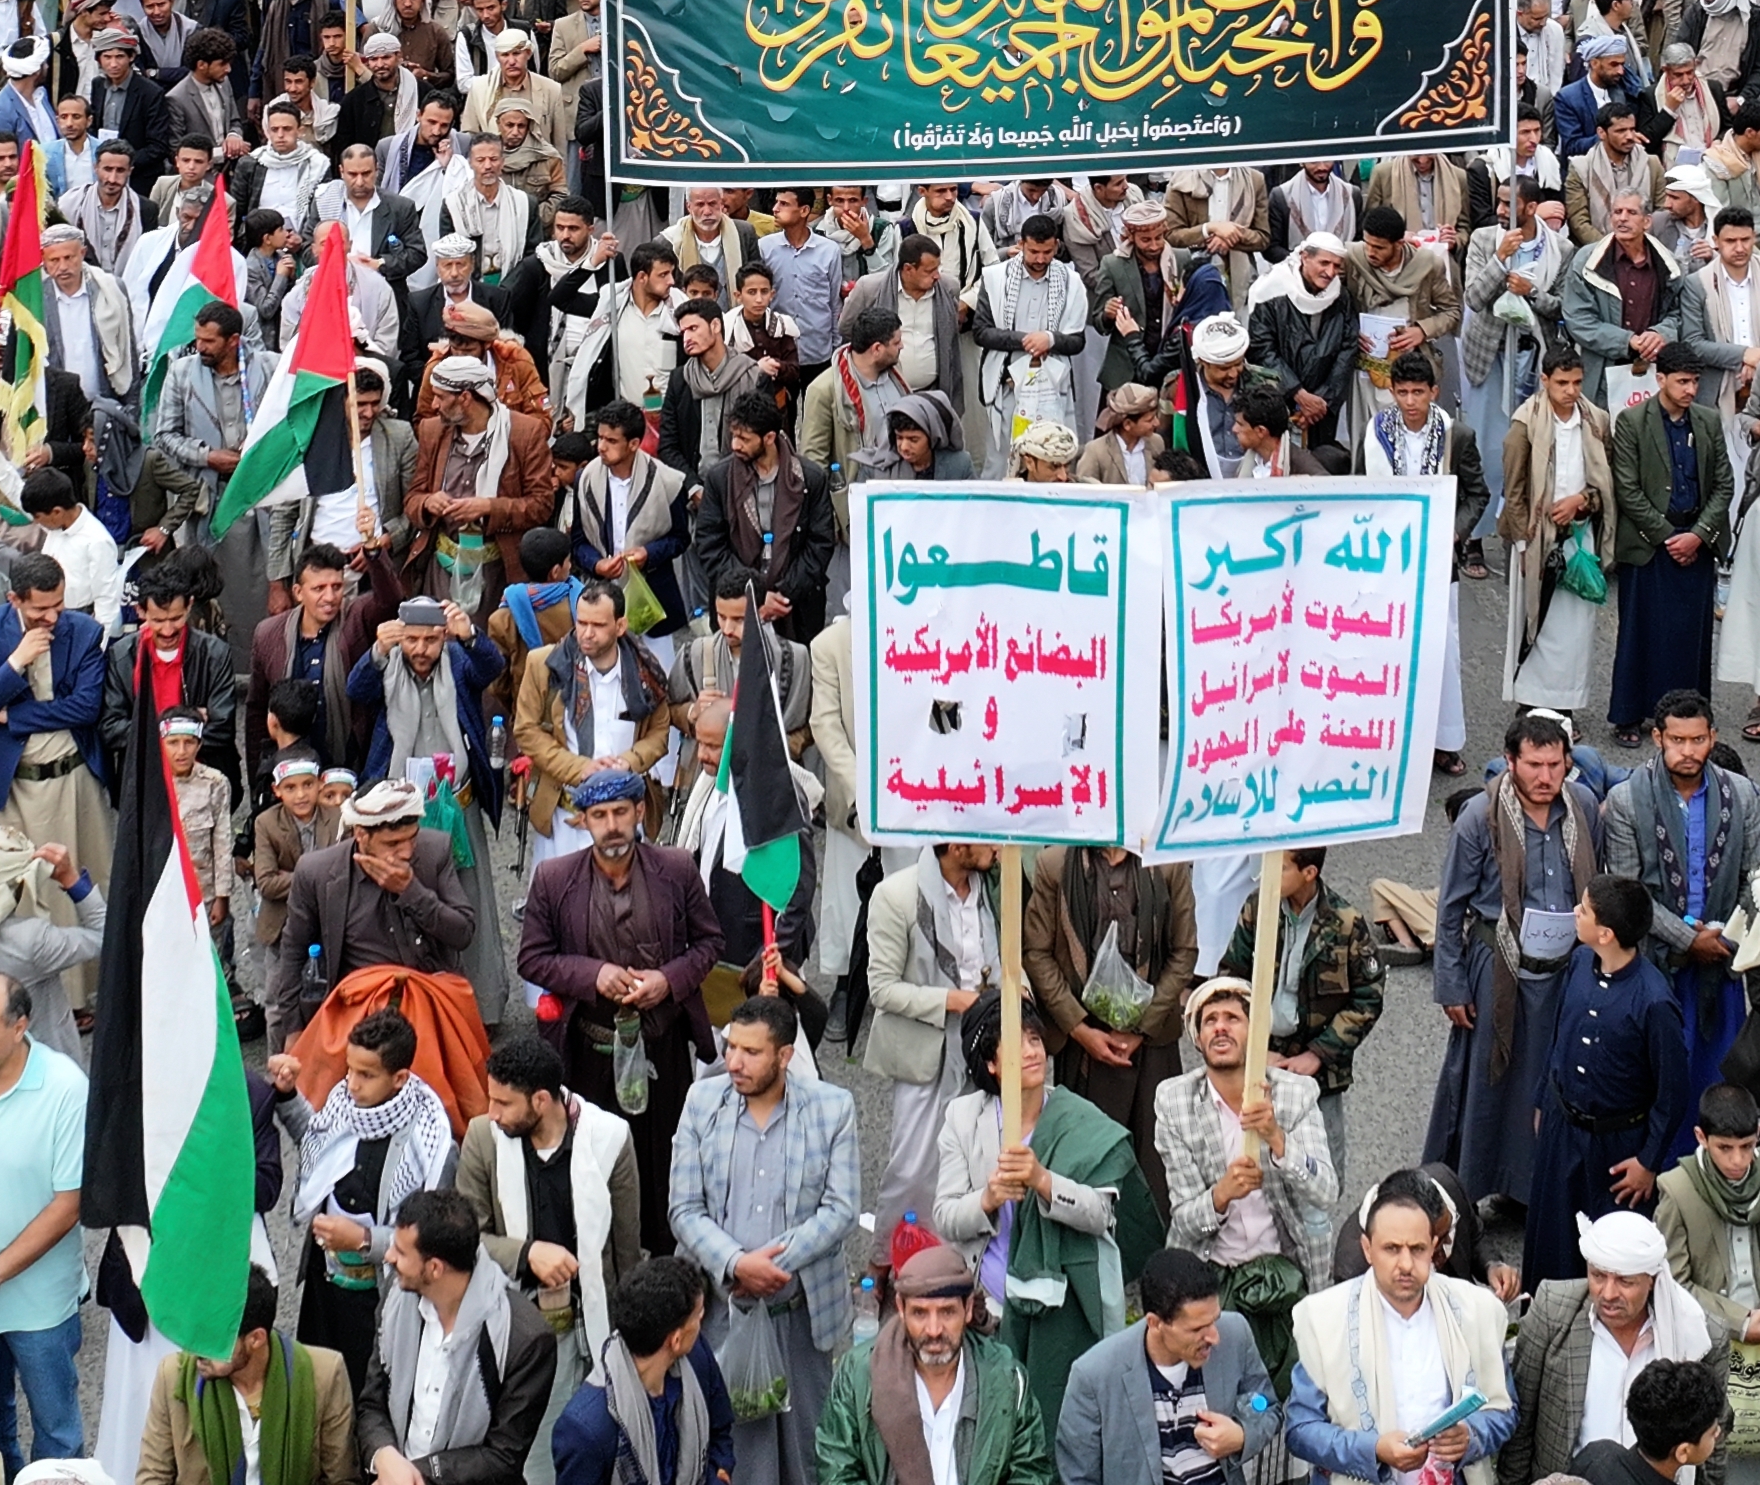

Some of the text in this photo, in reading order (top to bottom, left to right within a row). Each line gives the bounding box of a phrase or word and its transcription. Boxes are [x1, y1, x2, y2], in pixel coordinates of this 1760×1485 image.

[882, 526, 1110, 606] قاطعوا
[1189, 504, 1412, 597] الله أكبر
[1191, 581, 1406, 647] الموت لأمريكا
[884, 614, 1108, 690] البضائع الأمريكية
[1299, 664, 1401, 704] الموت
[982, 696, 998, 742] و
[1186, 709, 1396, 776] اللعنة على اليهود
[886, 764, 1108, 816] الإسرائيلية
[1172, 765, 1390, 833] النصر للإسلام
